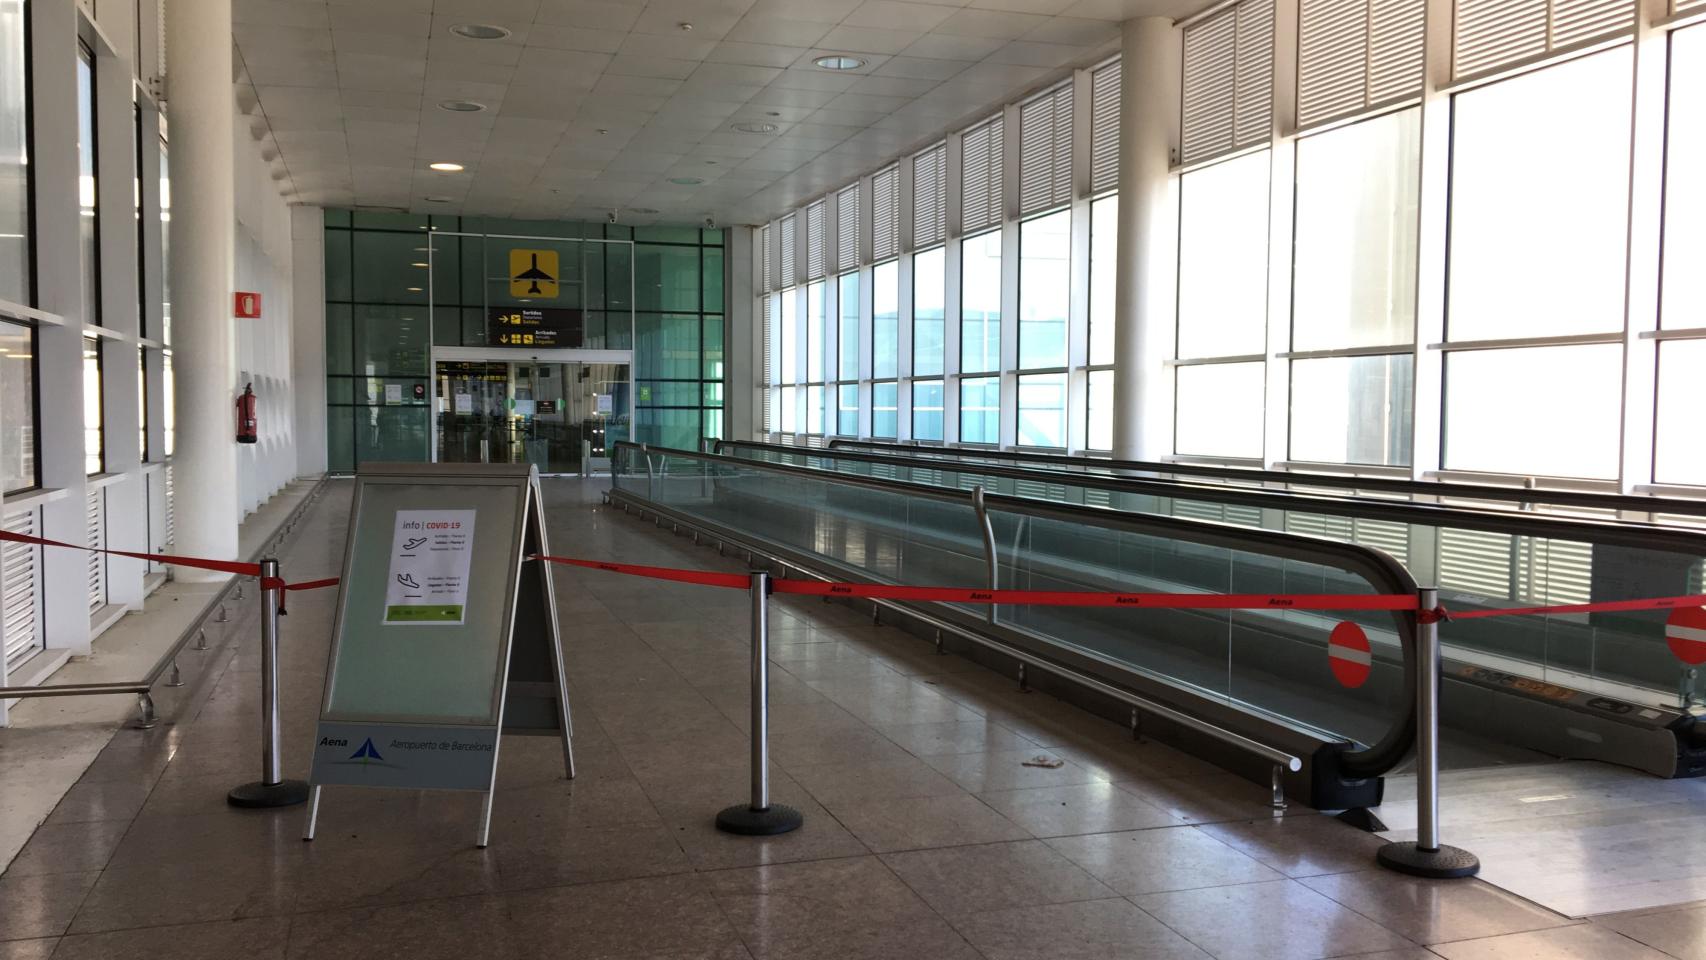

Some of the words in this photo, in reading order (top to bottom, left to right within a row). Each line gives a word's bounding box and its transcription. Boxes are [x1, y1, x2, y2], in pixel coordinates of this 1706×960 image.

[402, 521, 420, 530] info
[426, 521, 461, 529] COVID-19
[830, 585, 852, 593] Aena
[970, 592, 992, 600] Aena
[1116, 596, 1139, 604] Aena
[1268, 598, 1293, 606] Aena
[319, 736, 348, 747] Aena
[390, 739, 437, 750] Aeropuerto
[438, 740, 450, 750] de
[451, 741, 493, 751] Barcelona
